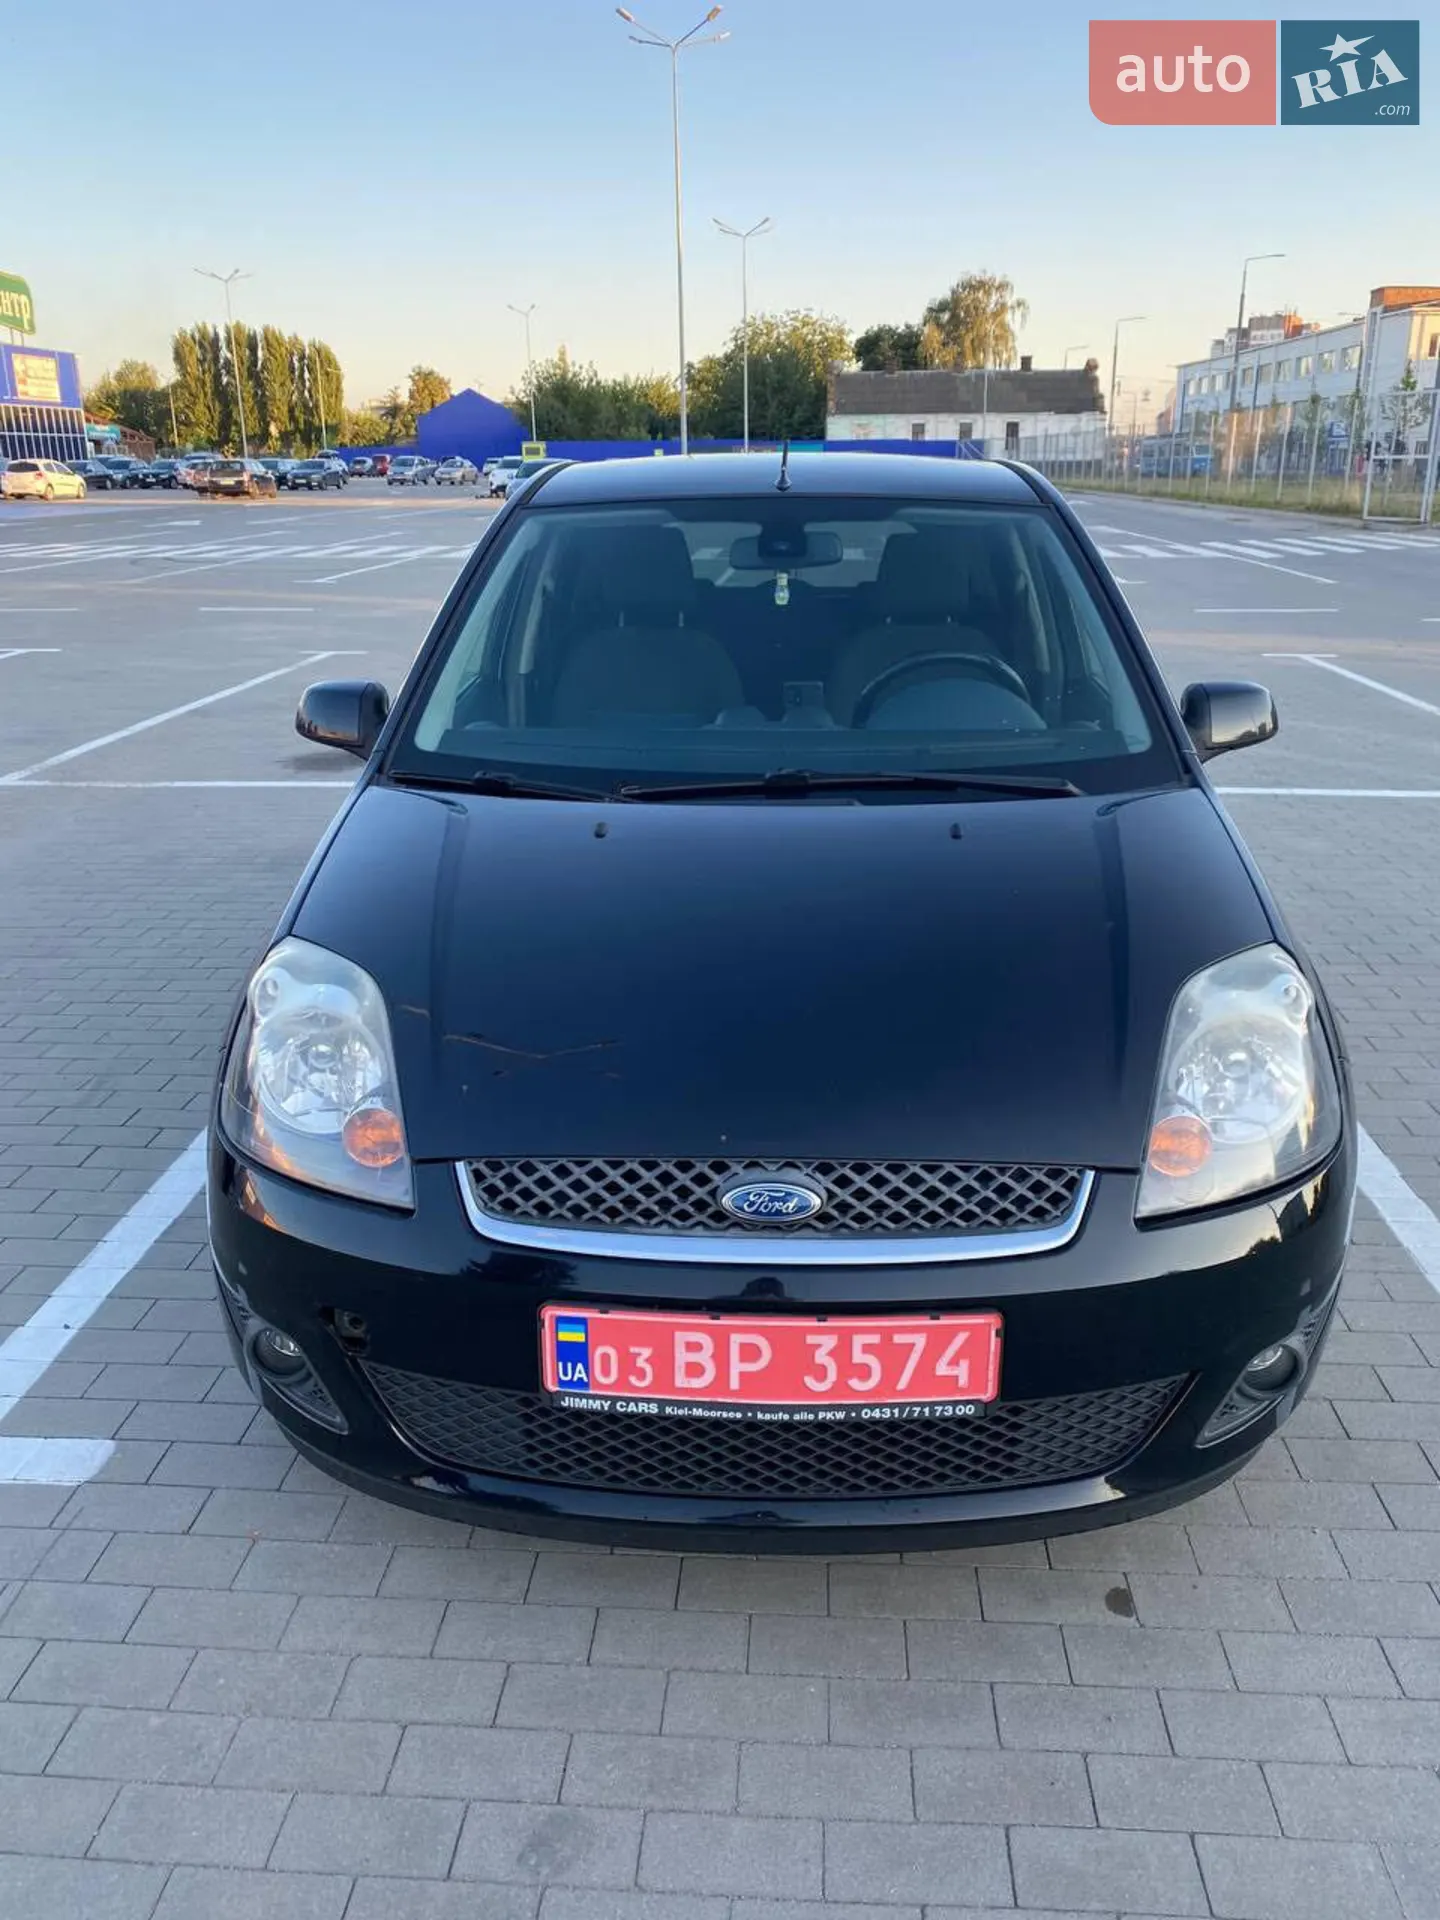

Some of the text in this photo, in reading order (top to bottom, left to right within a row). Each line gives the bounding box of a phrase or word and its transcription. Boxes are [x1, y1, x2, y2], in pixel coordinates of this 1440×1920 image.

[0, 290, 31, 330] нтр
[743, 1190, 799, 1213] Ford
[558, 1361, 589, 1382] UA
[593, 1331, 971, 1393] 03 BP 3574
[560, 1396, 611, 1411] JIMMY
[616, 1402, 659, 1414] CARS
[818, 1411, 846, 1420] PKW
